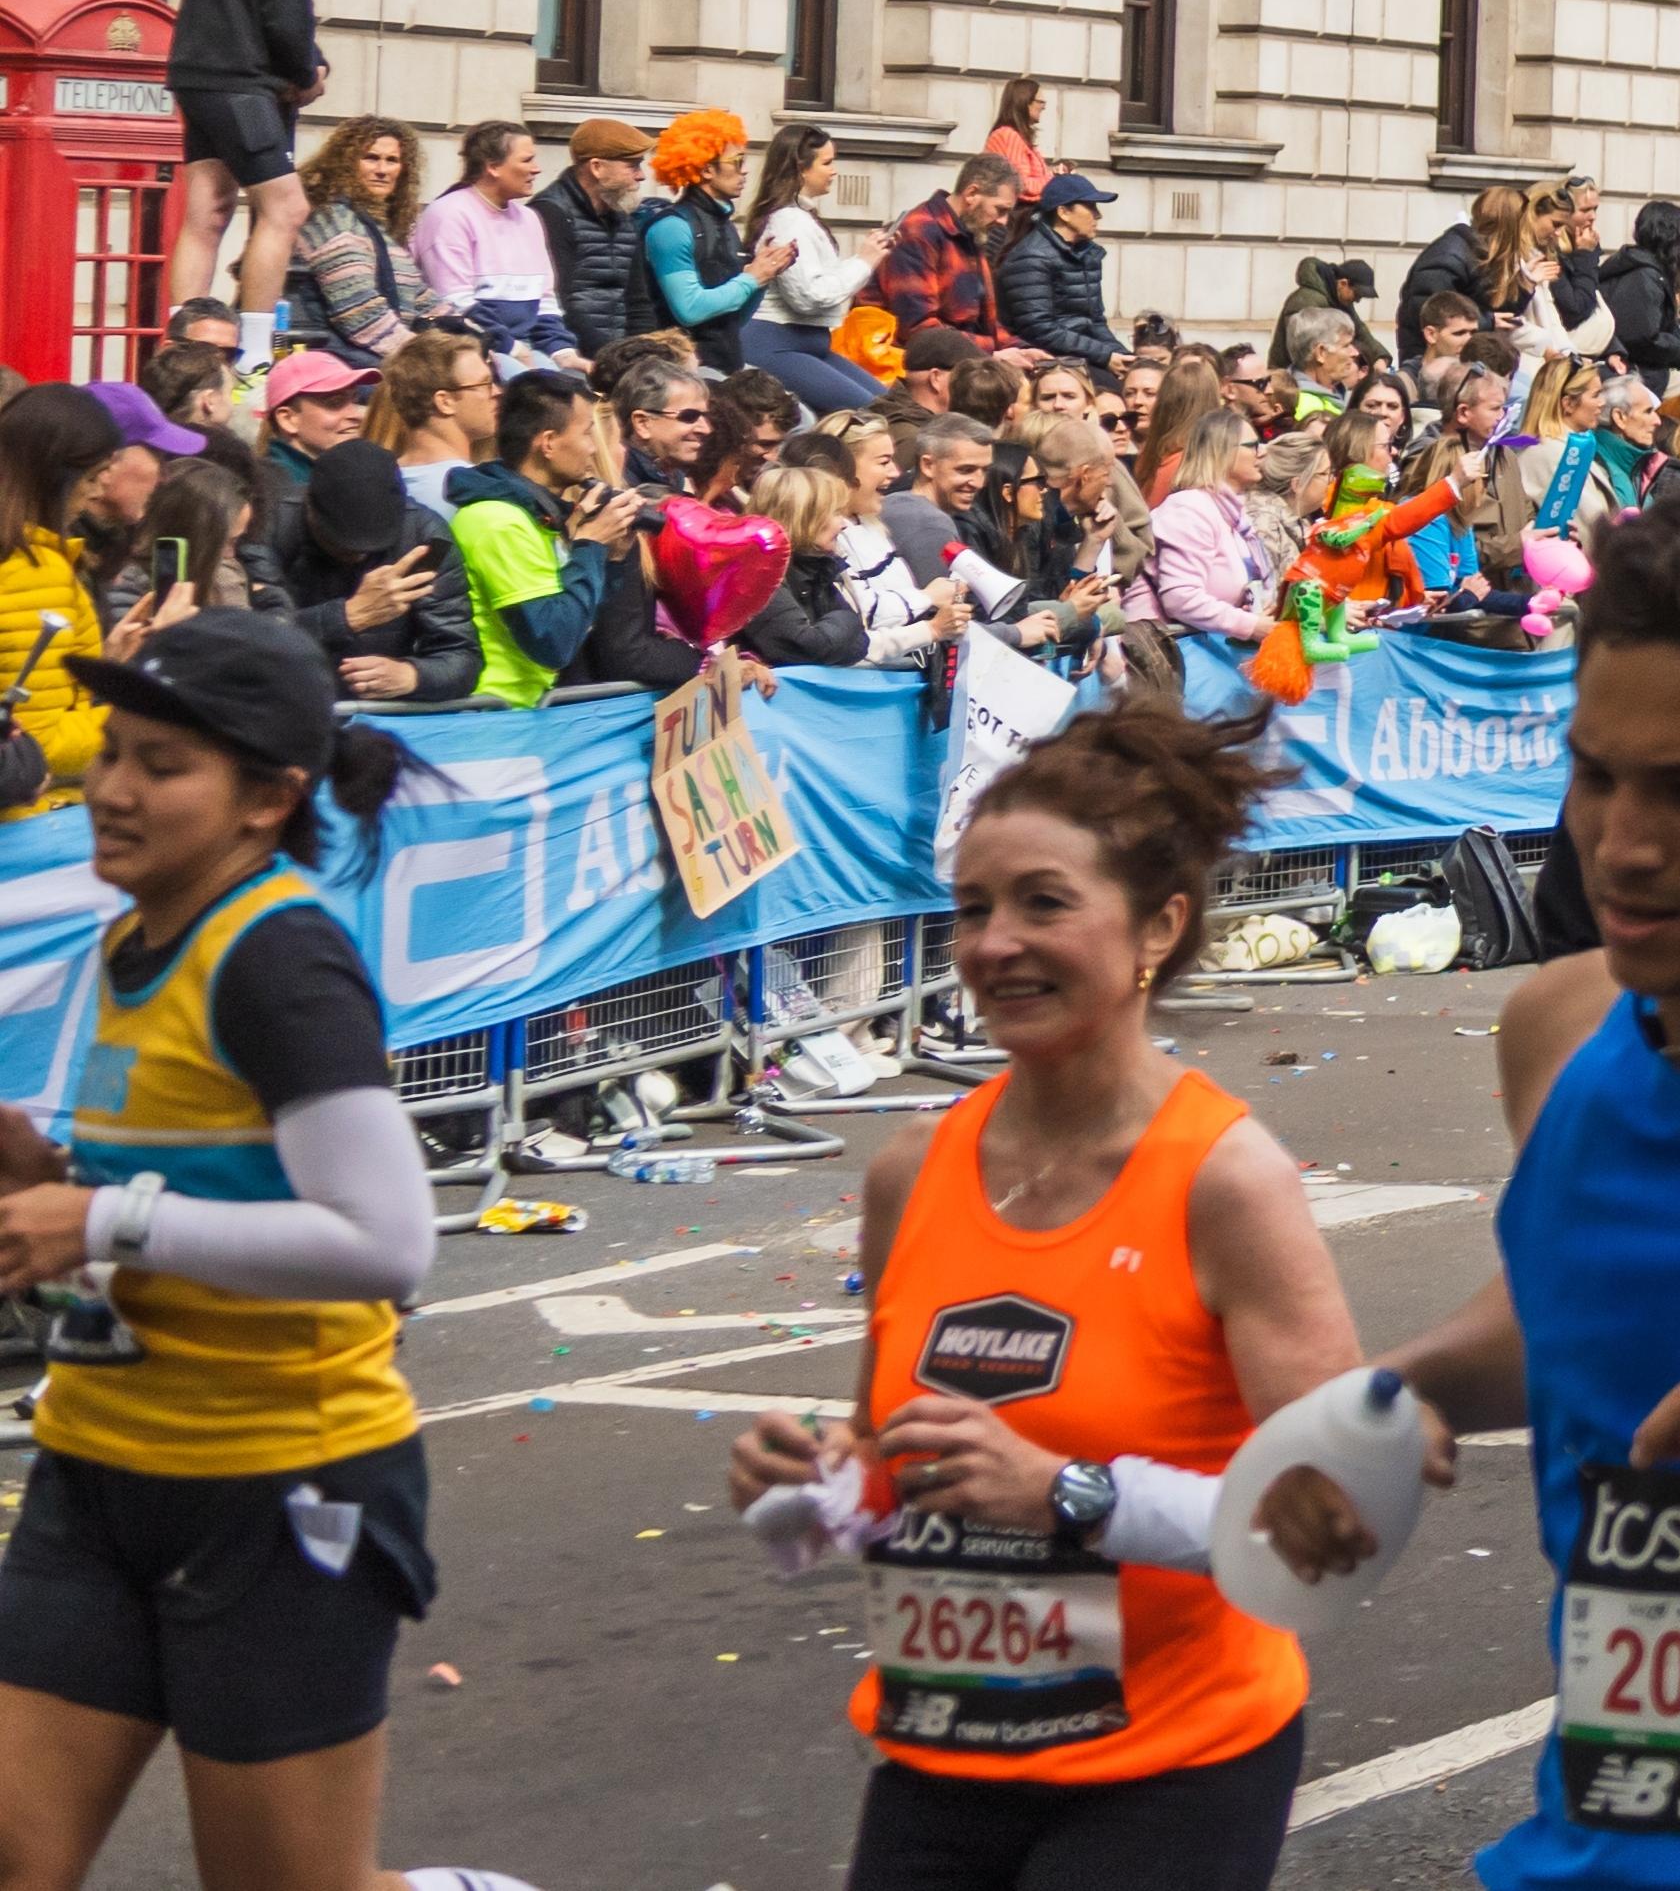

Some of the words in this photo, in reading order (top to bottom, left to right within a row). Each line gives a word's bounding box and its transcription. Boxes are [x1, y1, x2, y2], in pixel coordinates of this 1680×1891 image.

[58, 80, 170, 113] TELEPHONE
[1369, 693, 1560, 782] Abbott
[665, 739, 770, 855] SASHA
[703, 809, 781, 889] TURN
[934, 1325, 1060, 1361] HOYLAKE
[960, 1535, 1052, 1561] SERVICES
[898, 1593, 1074, 1667] 26264
[955, 1719, 998, 1743] new
[1000, 1709, 1100, 1742] balance
[1580, 1754, 1679, 1817] NB
